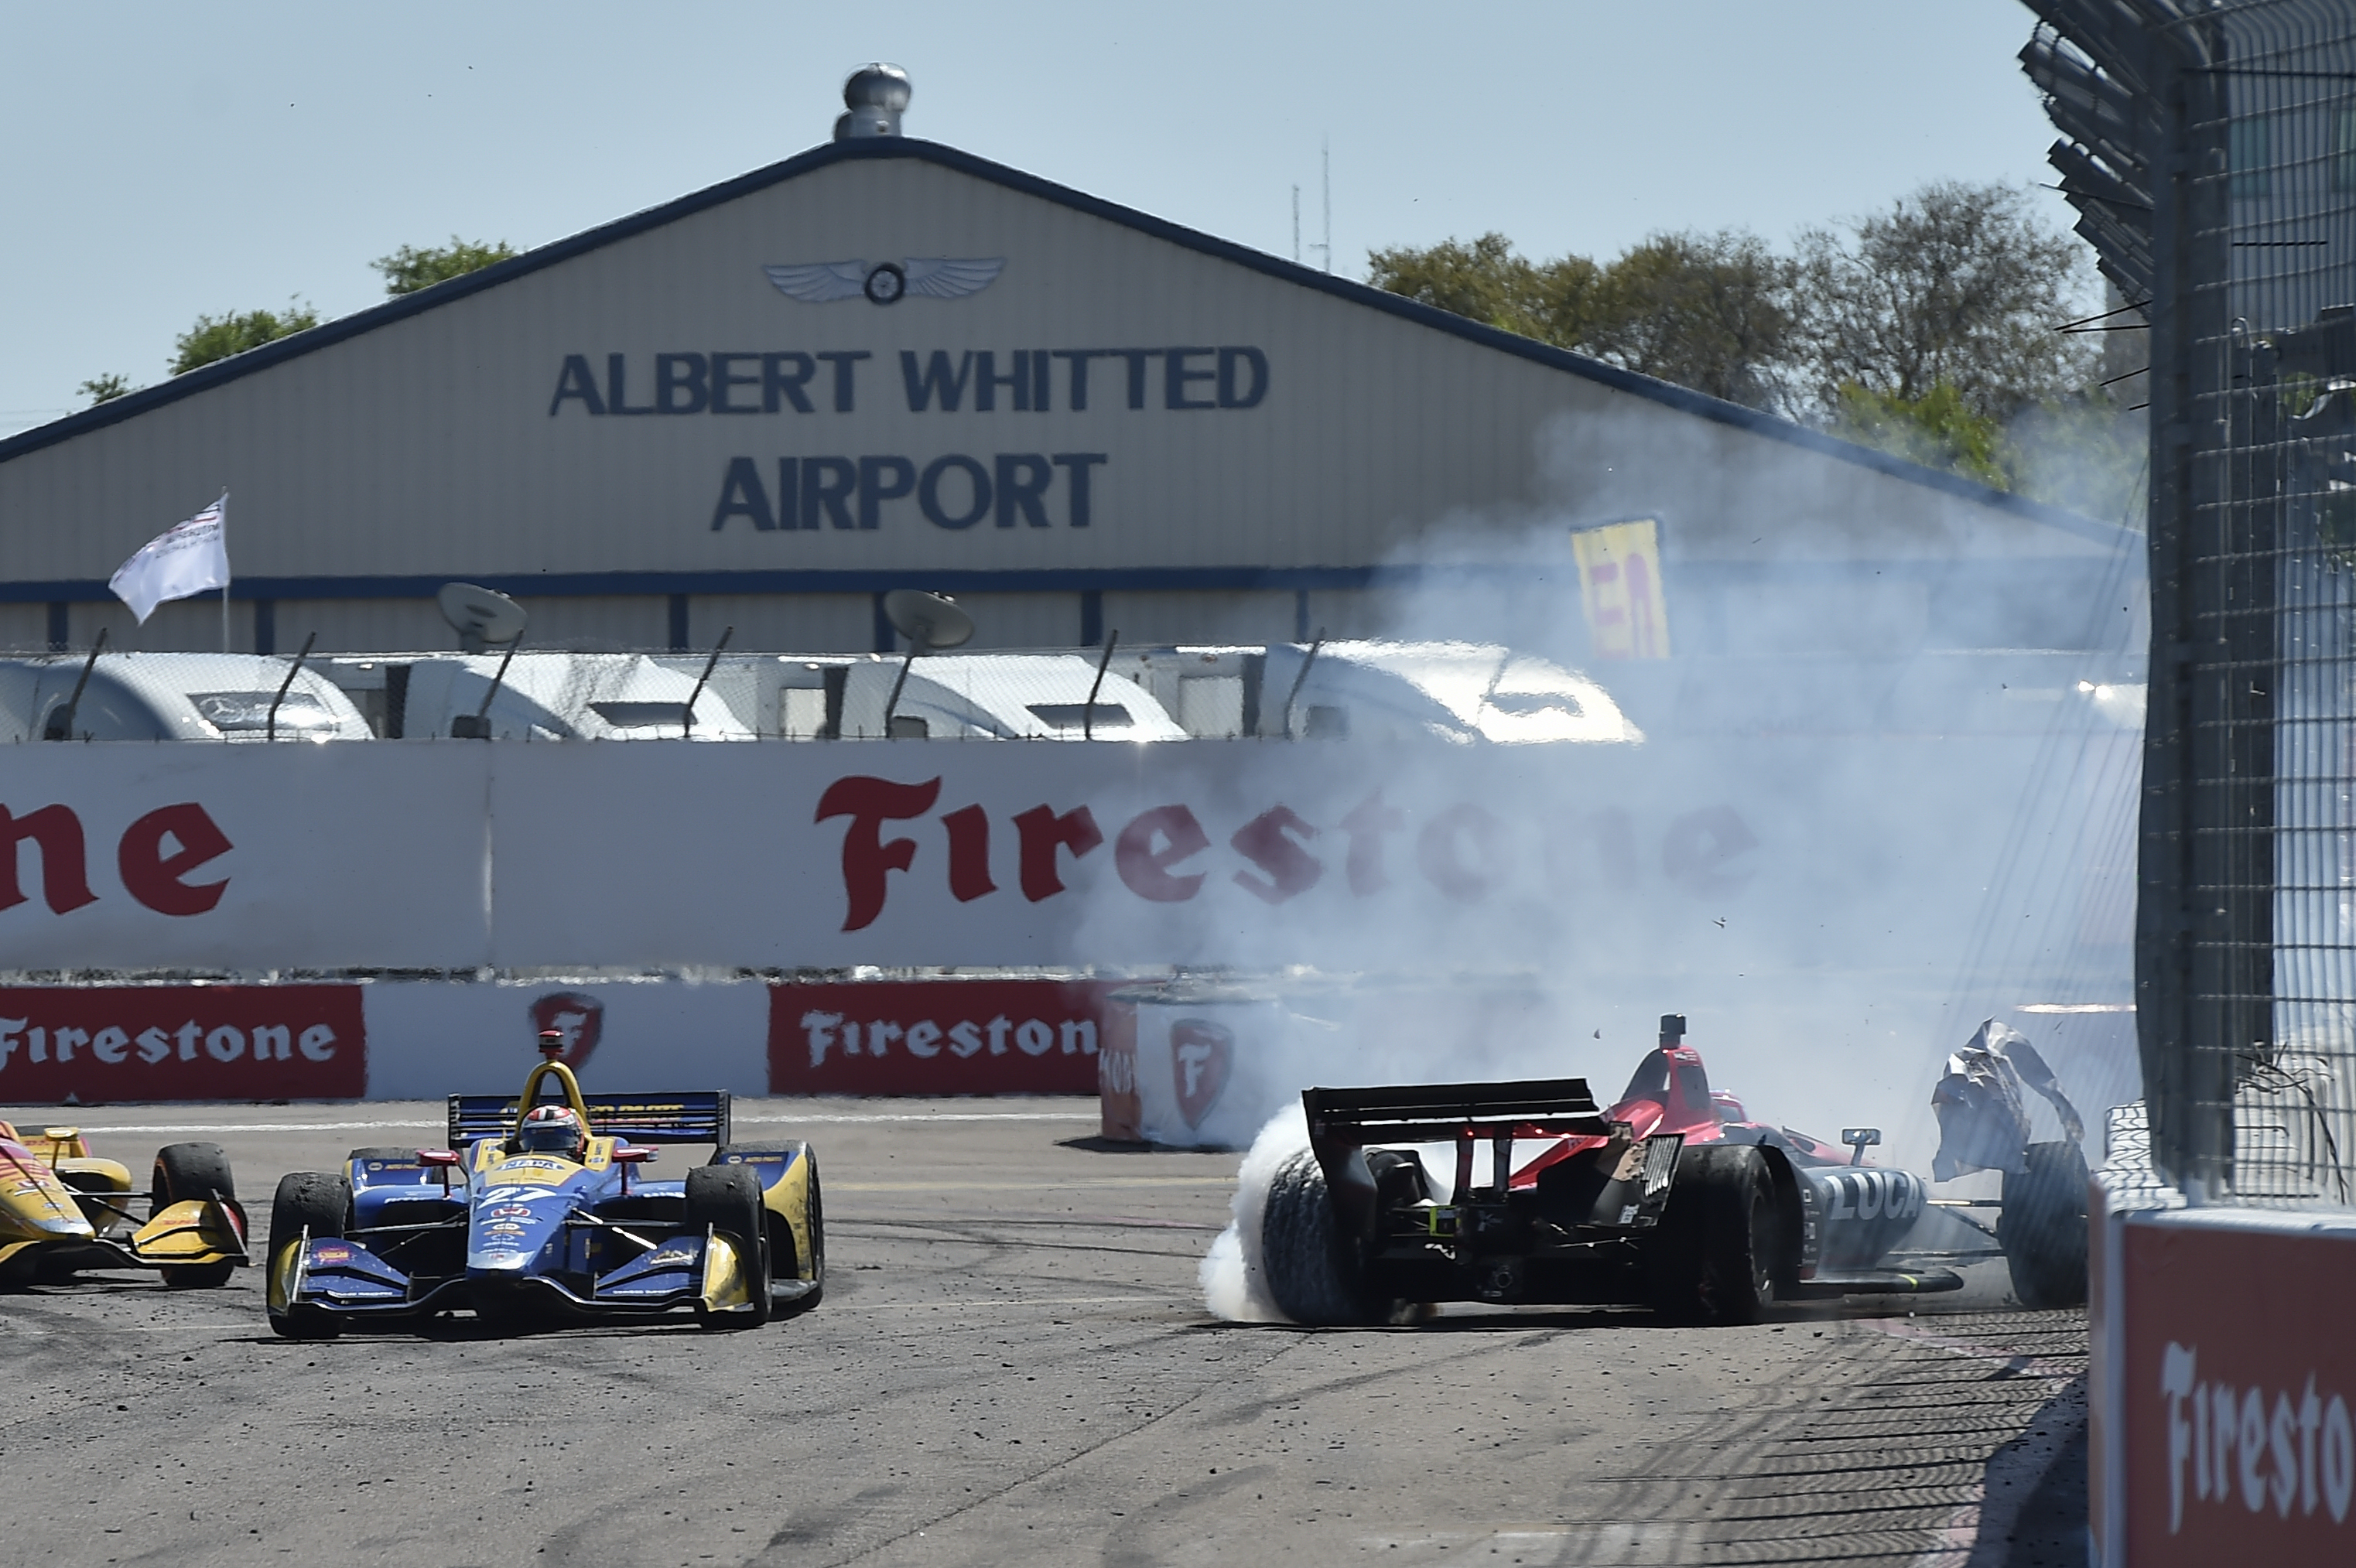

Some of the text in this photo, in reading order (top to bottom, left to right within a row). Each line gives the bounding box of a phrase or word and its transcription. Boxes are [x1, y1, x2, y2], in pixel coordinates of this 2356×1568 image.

[550, 346, 1270, 416] ALBERT WHITTED
[713, 452, 1107, 531] AIRPORT
[814, 774, 1759, 932] Firestone
[800, 1009, 1100, 1068] Fireston
[503, 1160, 556, 1170] NAPA
[1824, 1170, 1923, 1220] LUCA
[477, 1187, 557, 1208] 27
[2161, 1340, 2354, 1536] Firesto
